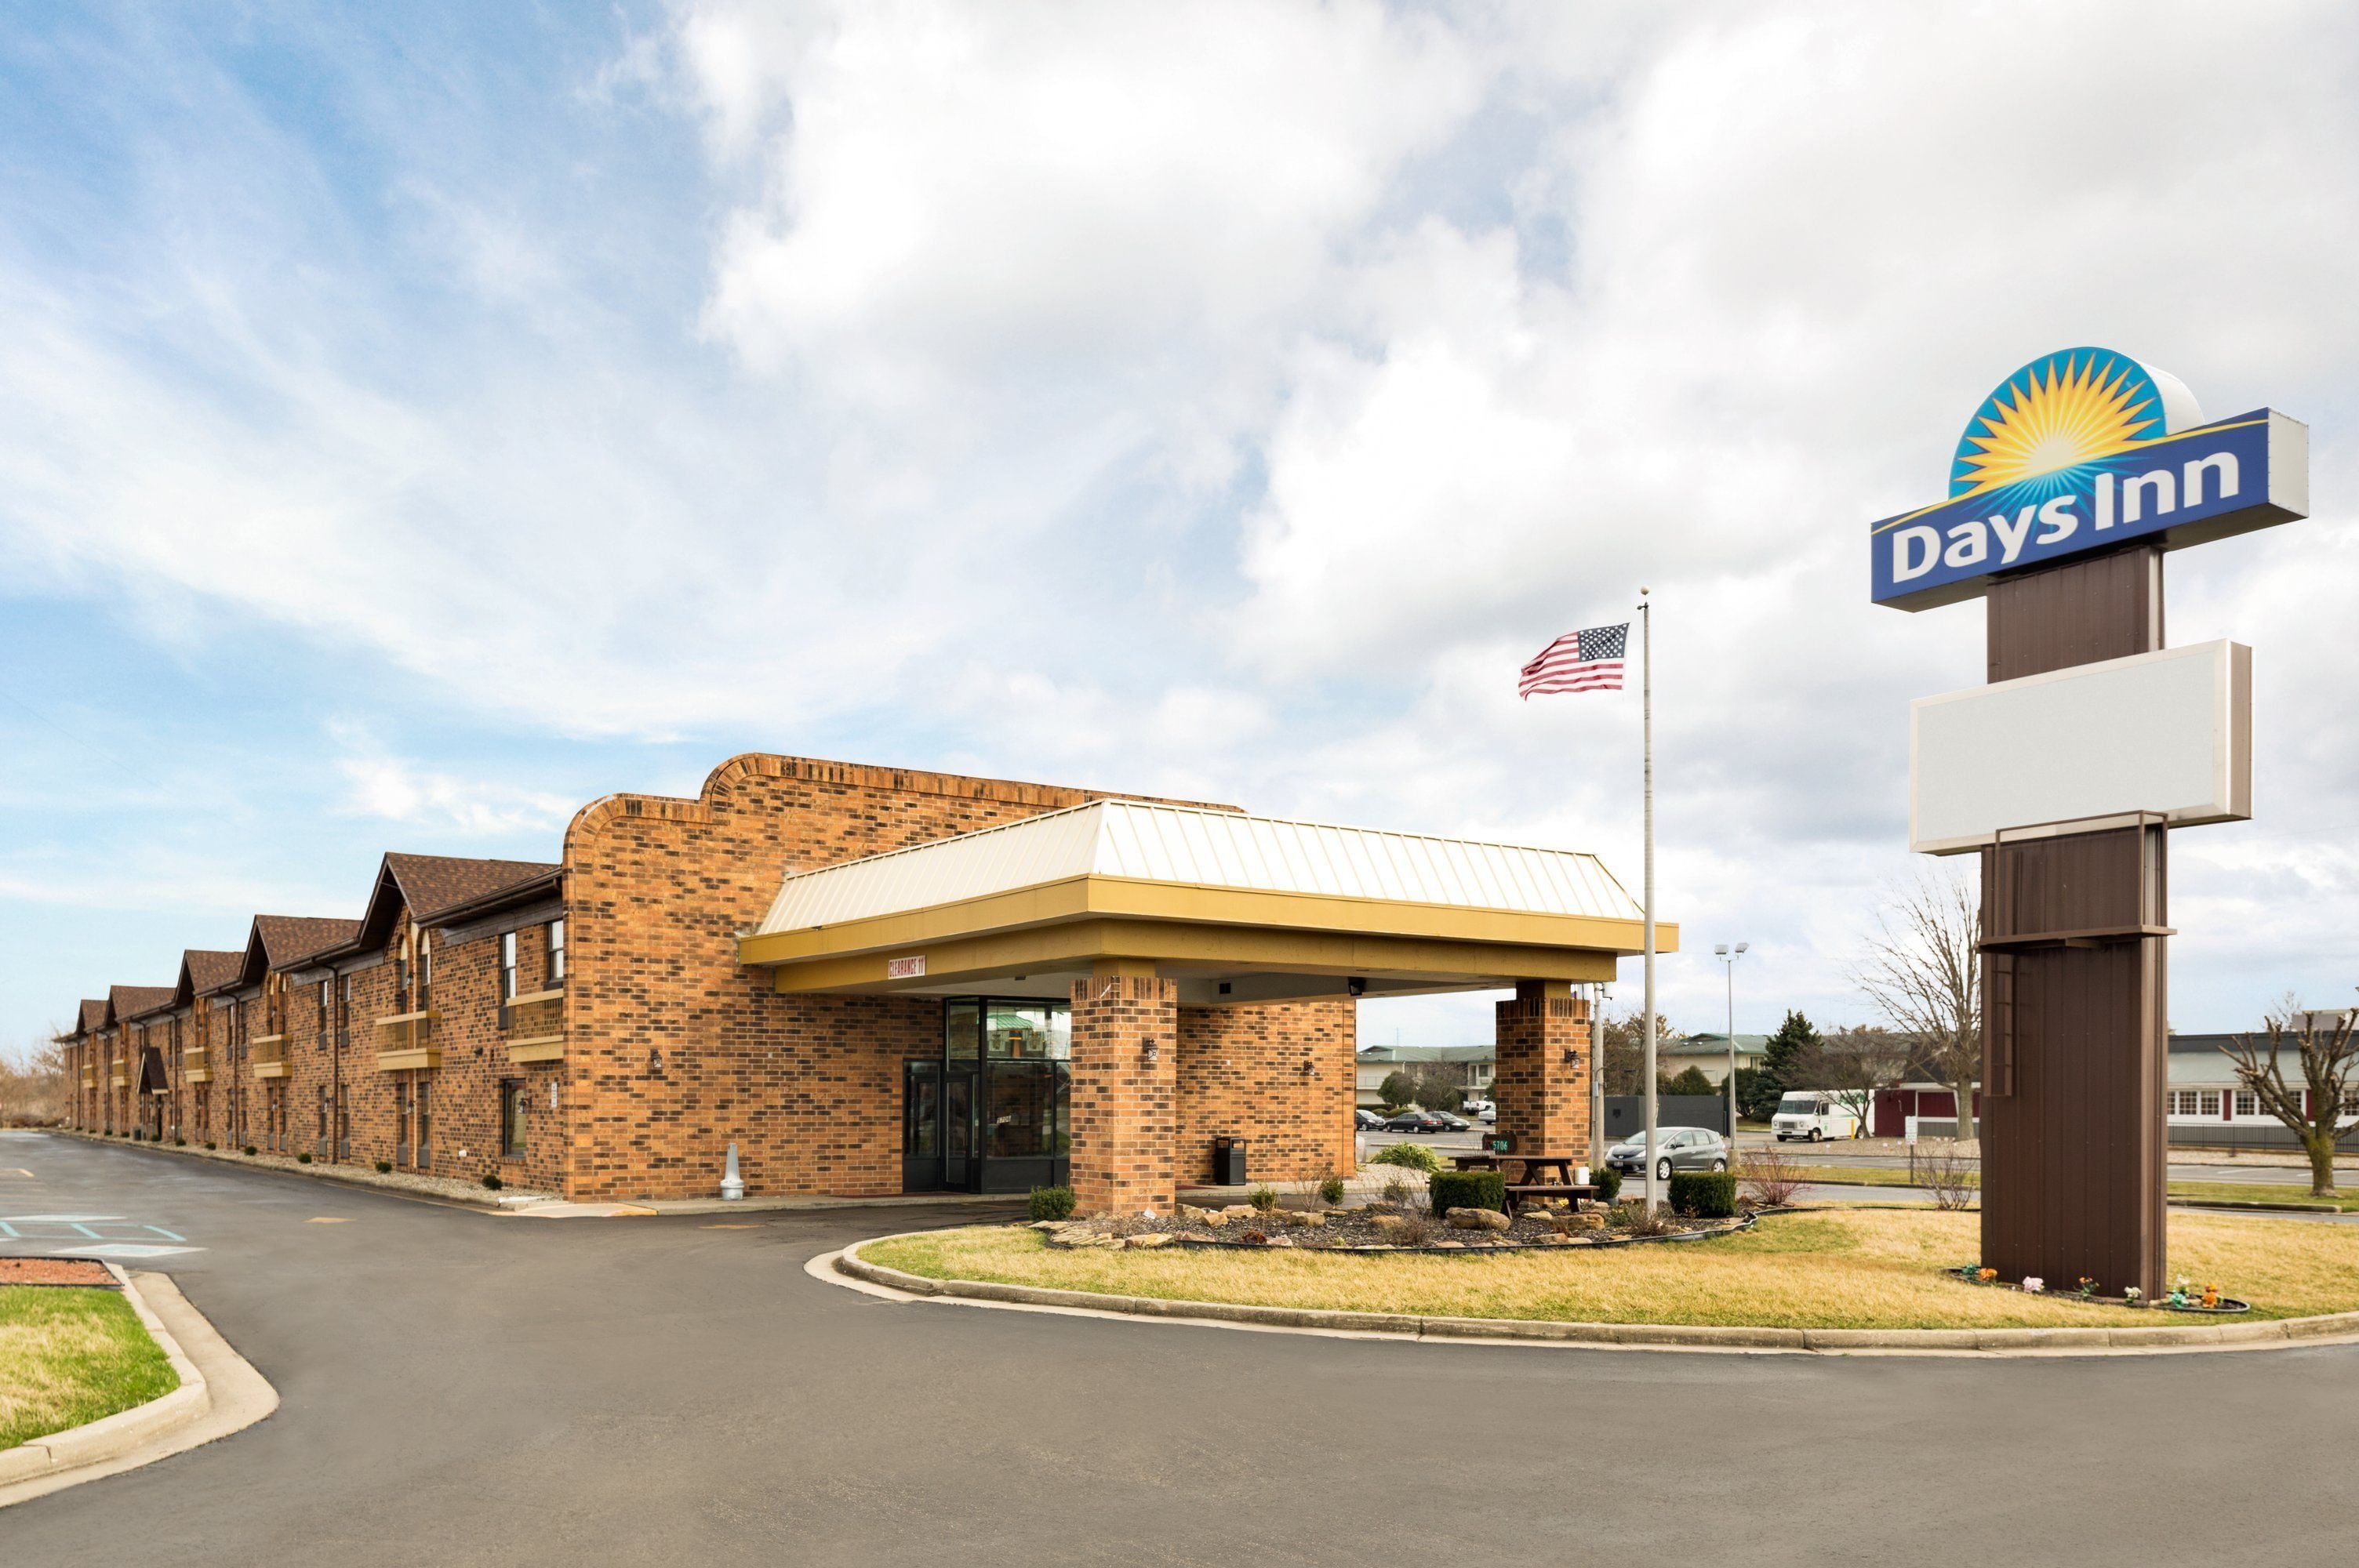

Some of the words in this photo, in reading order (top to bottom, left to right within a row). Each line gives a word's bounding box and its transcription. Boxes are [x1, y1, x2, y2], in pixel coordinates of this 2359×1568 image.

[1893, 495, 2078, 583] Days
[2095, 452, 2239, 531] Inn
[889, 959, 916, 977] CLEARANCE
[1492, 1140, 1508, 1151] 5706
